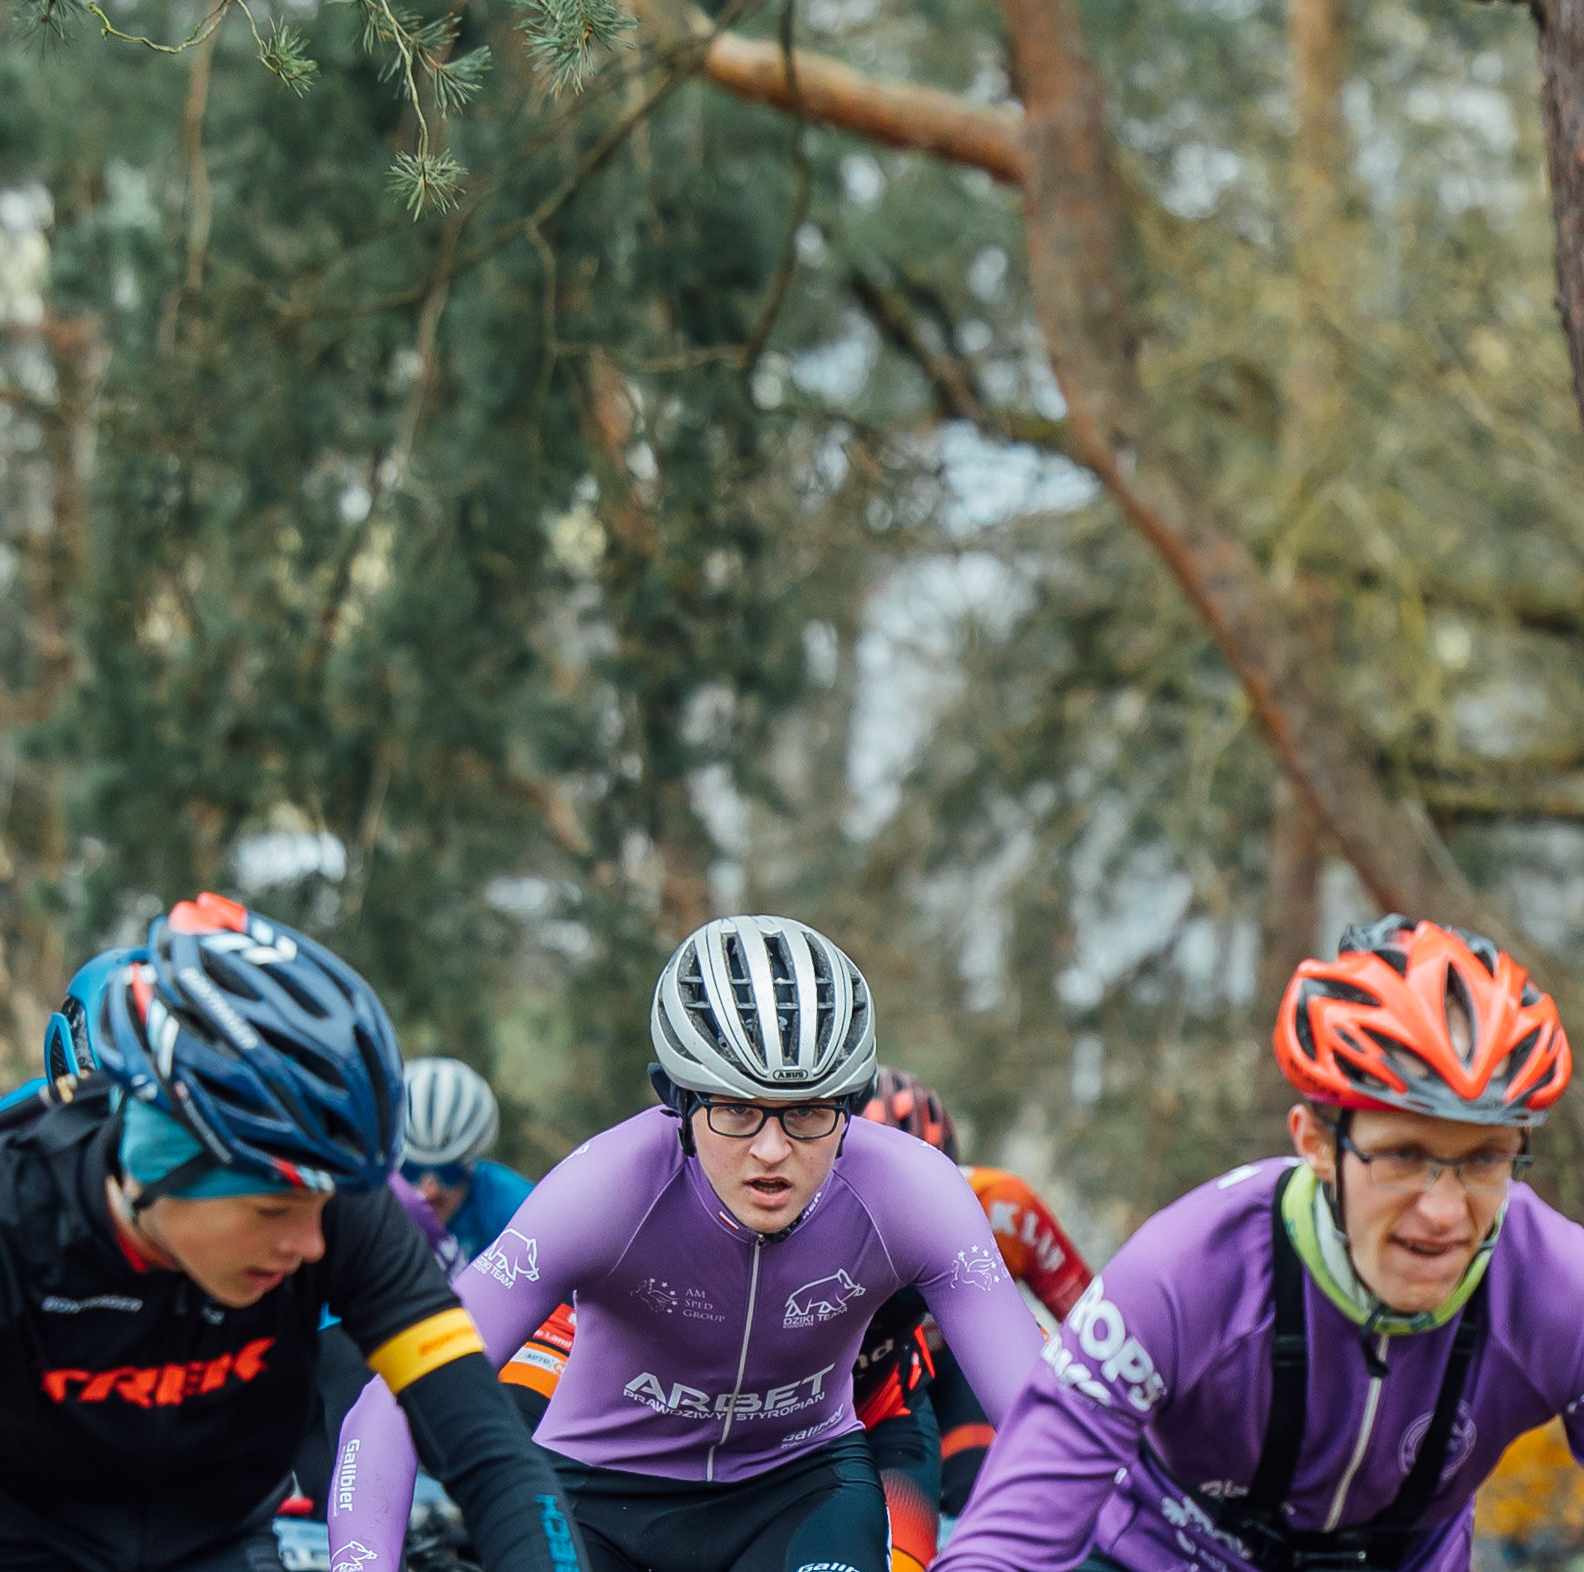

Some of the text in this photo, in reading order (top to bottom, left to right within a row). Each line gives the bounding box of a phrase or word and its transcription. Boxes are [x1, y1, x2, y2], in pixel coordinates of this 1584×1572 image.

[490, 1265, 515, 1290] TEAM
[686, 1288, 706, 1299] AM
[783, 1306, 848, 1326] DZIKI TEAM
[526, 1351, 551, 1365] AUTO
[624, 1362, 836, 1413] ARBET
[623, 1388, 826, 1421] PRAWDZIWY STYROPIAN
[339, 1438, 361, 1512] Galibier
